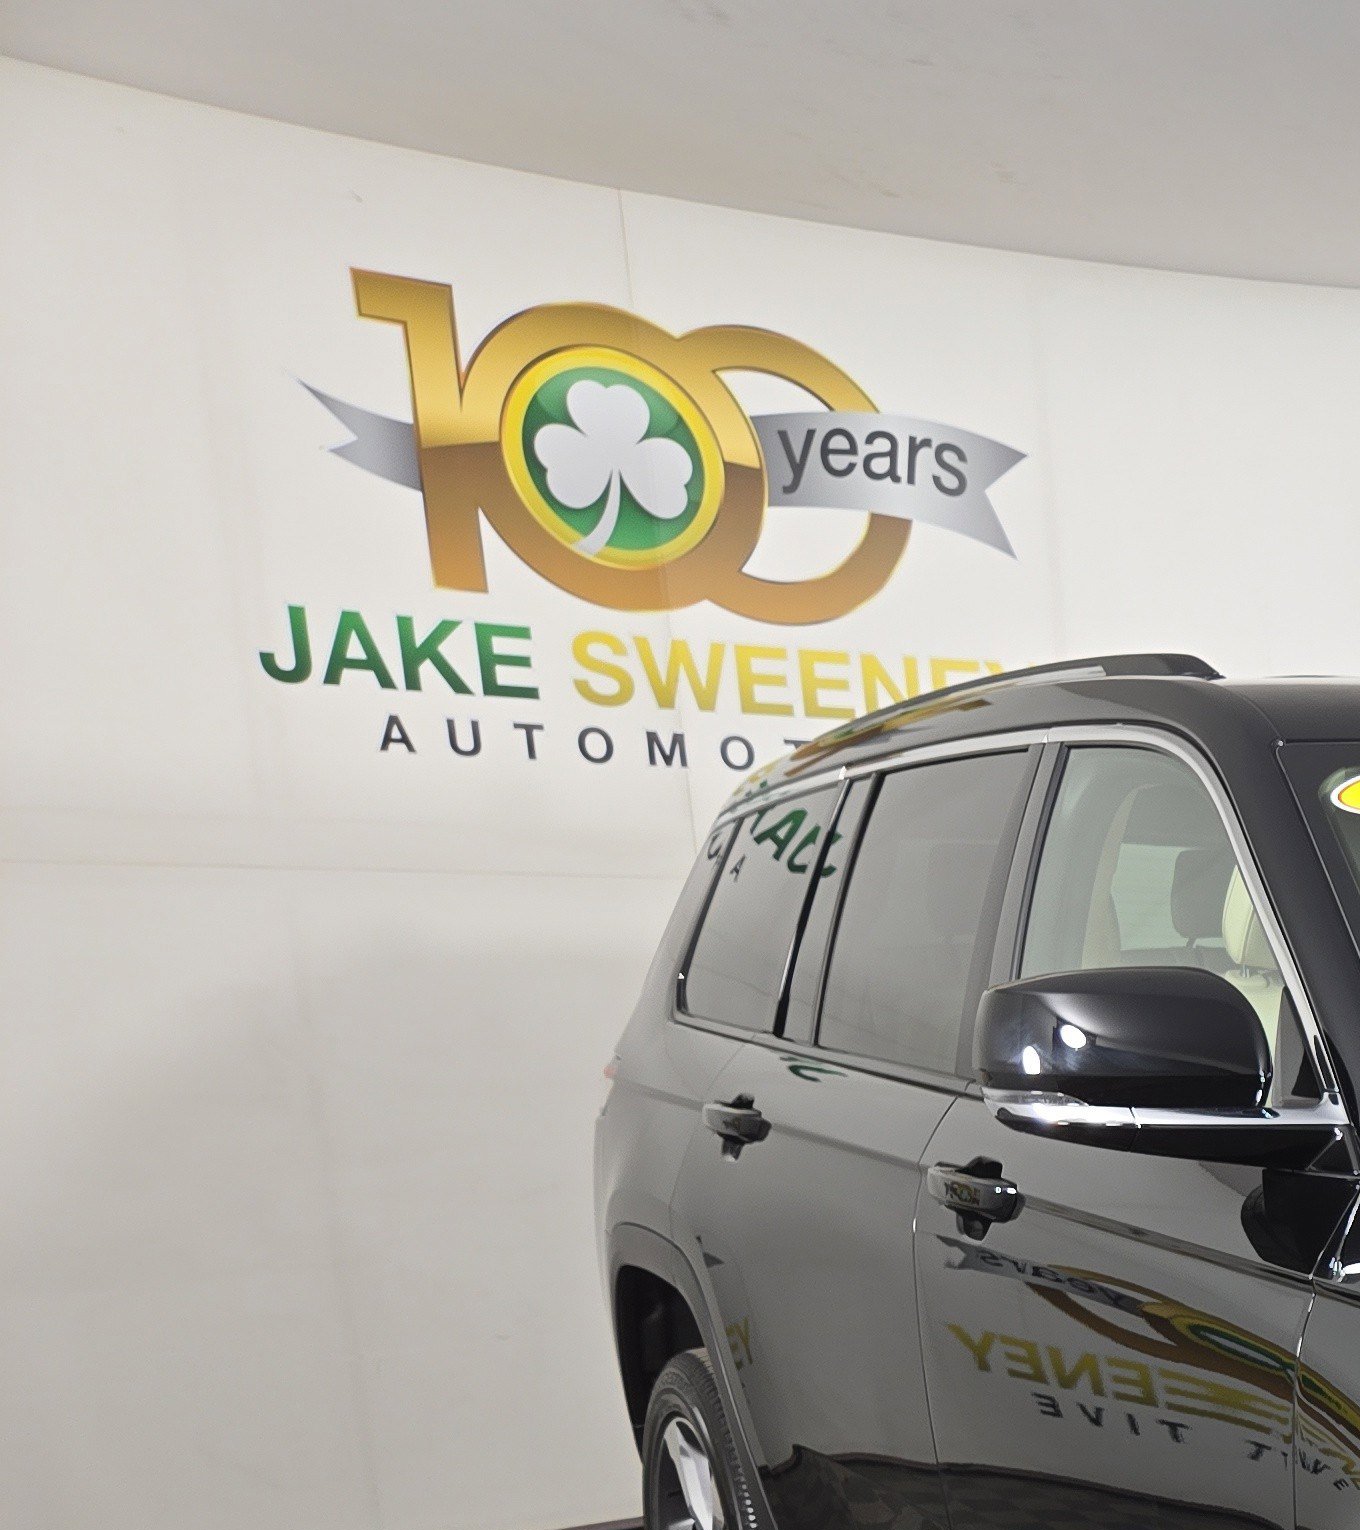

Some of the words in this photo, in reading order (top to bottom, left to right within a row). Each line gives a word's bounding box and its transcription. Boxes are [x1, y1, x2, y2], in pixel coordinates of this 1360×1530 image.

[349, 266, 913, 626] 100
[777, 425, 969, 497] years
[258, 603, 541, 700] JAKE
[571, 630, 1036, 721] SWEEN
[379, 713, 812, 771] AUTOMO
